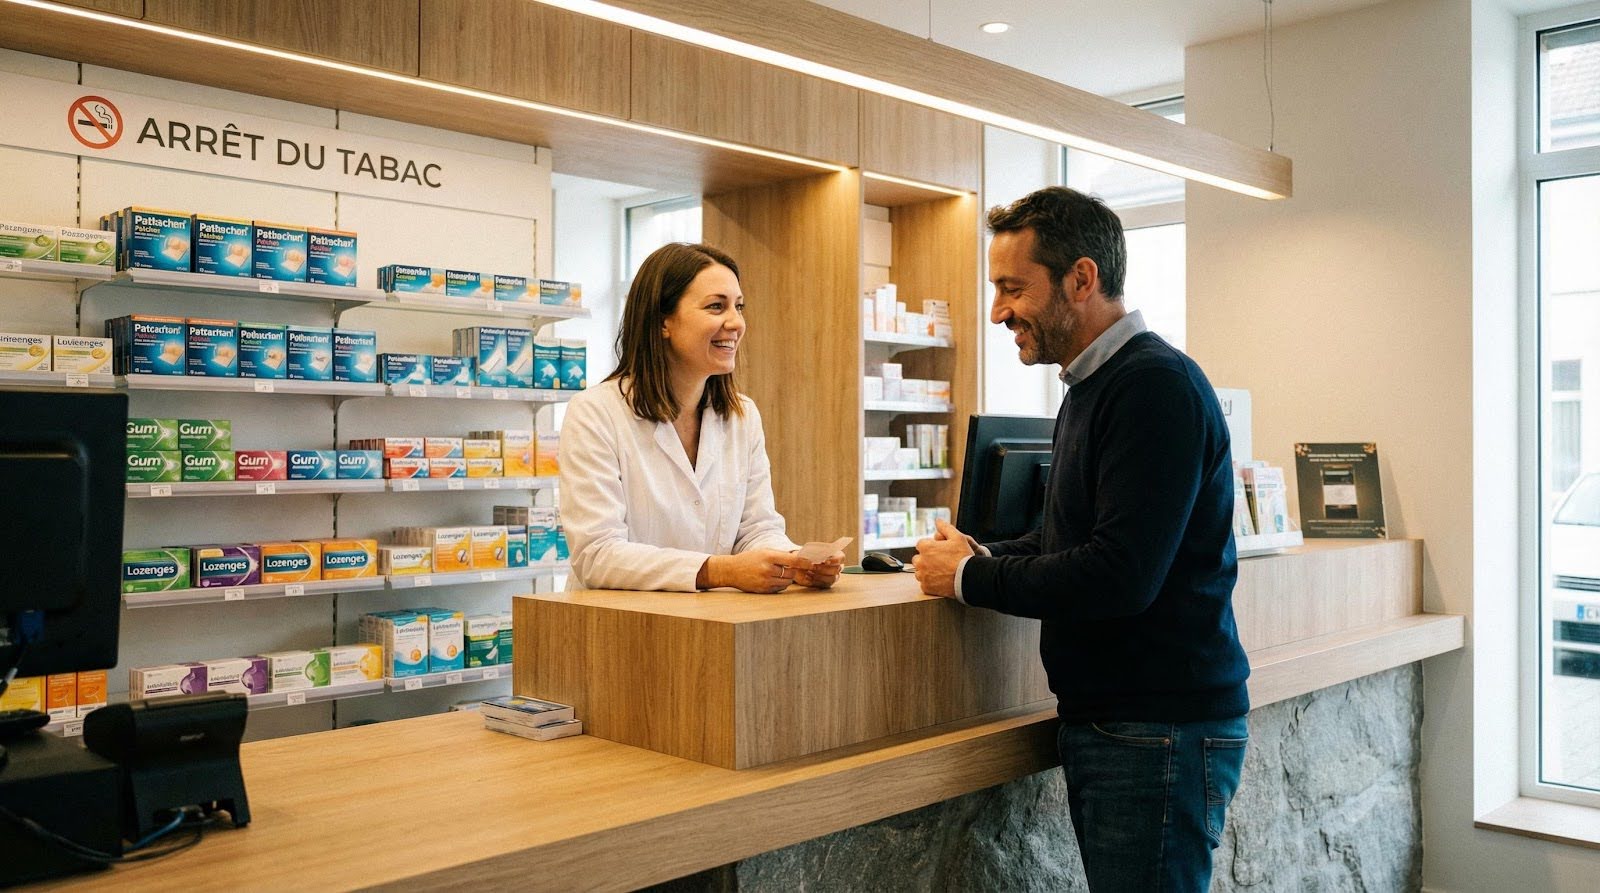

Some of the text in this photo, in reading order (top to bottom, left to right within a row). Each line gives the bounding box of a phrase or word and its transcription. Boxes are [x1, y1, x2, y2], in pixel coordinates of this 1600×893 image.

[137, 117, 443, 189] ARRÊT DU TABAC
[126, 422, 158, 434] Gum
[180, 423, 213, 434] Gum
[127, 454, 161, 467] Gum
[184, 454, 216, 466] Gum
[238, 454, 269, 466] Gum
[291, 453, 319, 465] Gum
[338, 453, 366, 465] Gum
[267, 558, 308, 569] Lozenges
[325, 555, 366, 566] Lozenges
[127, 565, 175, 577] Lozenges
[203, 561, 247, 573] Lozenges
